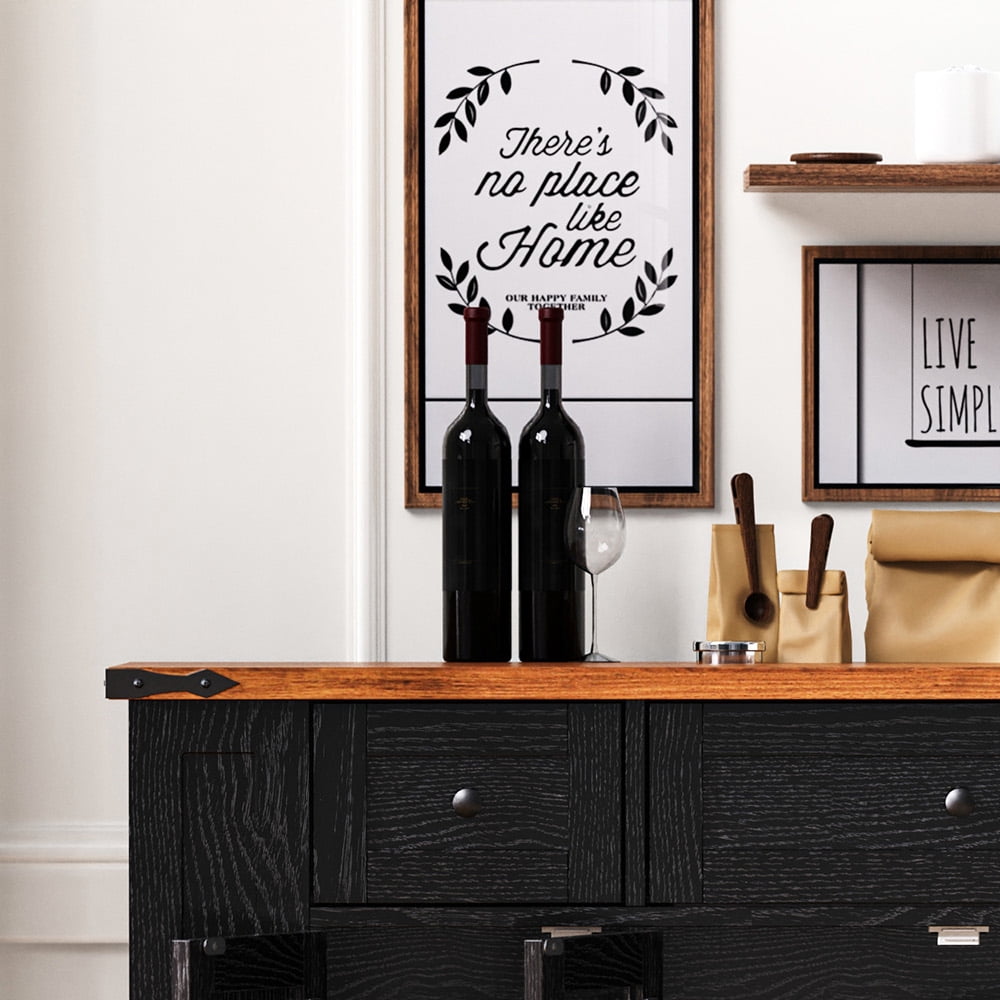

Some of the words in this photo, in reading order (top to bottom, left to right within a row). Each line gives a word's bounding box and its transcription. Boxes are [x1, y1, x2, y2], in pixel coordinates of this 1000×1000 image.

[500, 126, 613, 159] There's
[474, 170, 526, 197] no
[529, 161, 640, 207] place
[566, 202, 622, 231] like
[476, 222, 637, 271] Home
[505, 294, 528, 302] OUR
[531, 294, 567, 302] HAPPY
[570, 294, 608, 302] FAMILY
[923, 317, 977, 369] LIVE
